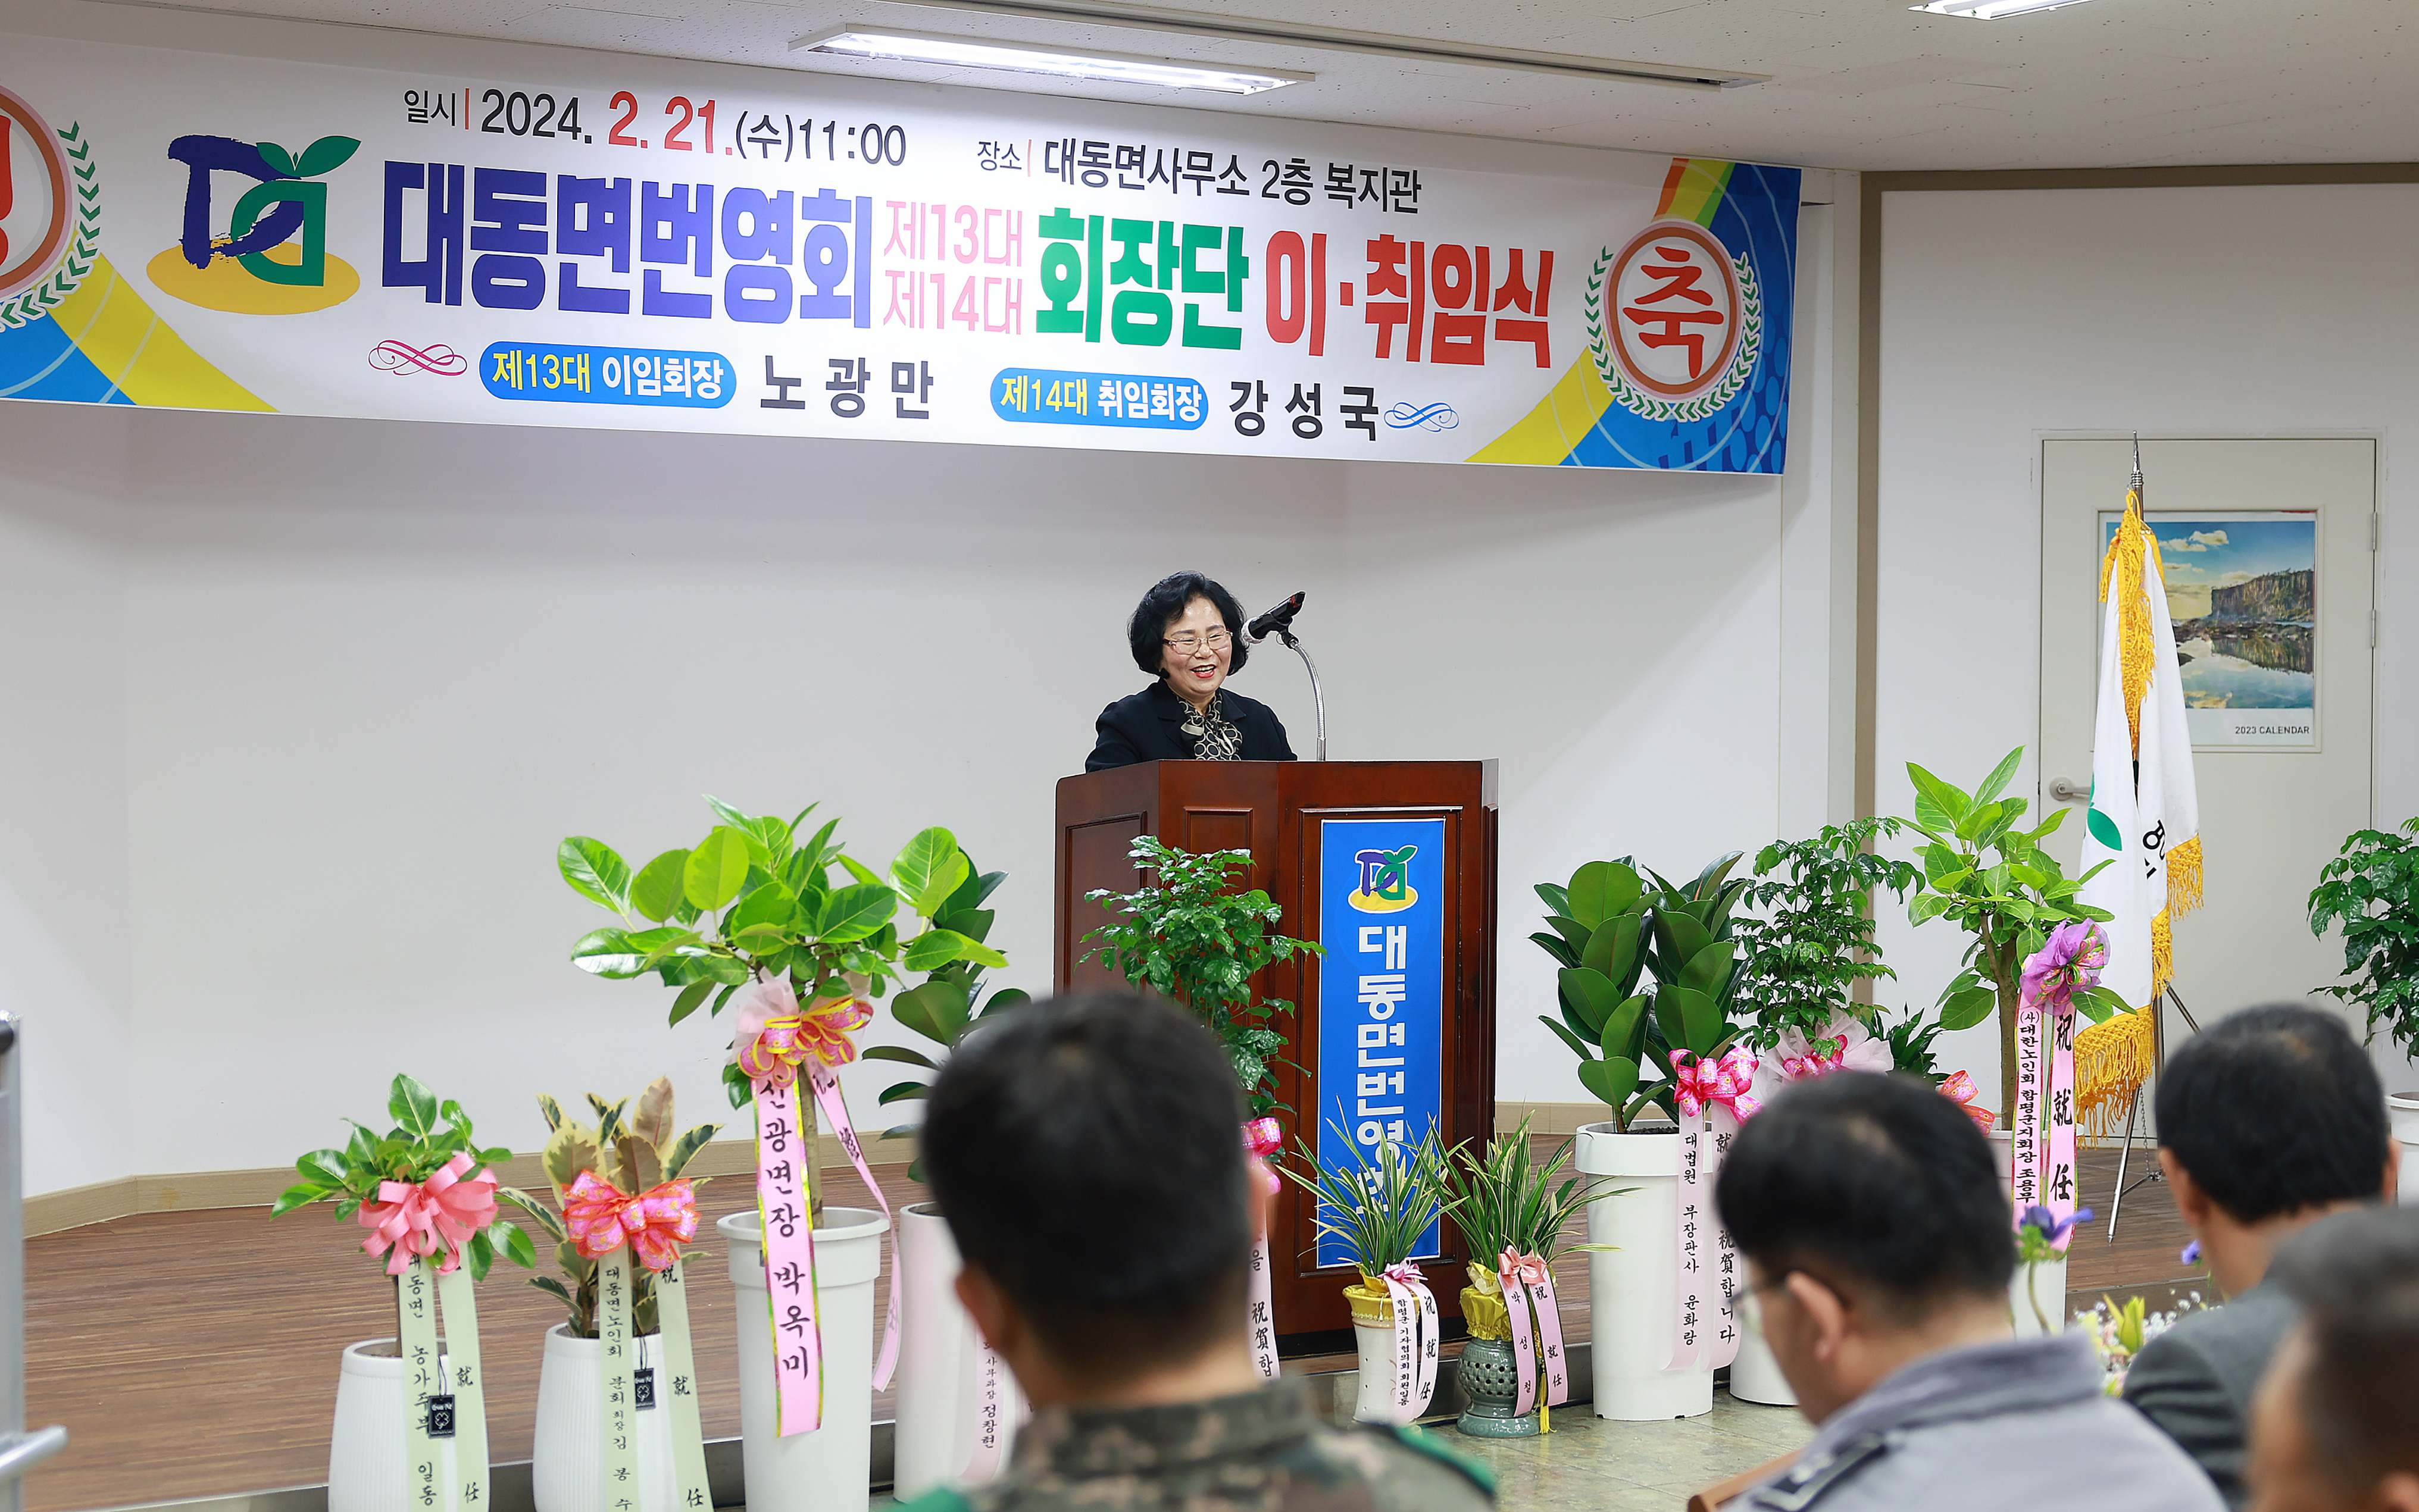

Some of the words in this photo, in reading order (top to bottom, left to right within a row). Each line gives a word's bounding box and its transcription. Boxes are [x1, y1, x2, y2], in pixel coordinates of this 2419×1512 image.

[404, 89, 456, 126] 일시
[481, 89, 592, 144] 2024.
[608, 91, 648, 148] 2.
[977, 140, 1022, 171] 장소
[1044, 138, 1250, 196] 대동면사무소
[1261, 158, 1313, 206] 2층
[1324, 162, 1421, 214] 복지관
[382, 160, 873, 328] 대동면번영회
[884, 200, 1023, 267] 제13대
[883, 270, 1022, 335] 제14대
[1036, 207, 1249, 350] 회장단
[1623, 246, 1724, 379] 축
[492, 350, 591, 394] 제13대
[602, 355, 724, 400] 이임회장
[1000, 375, 1089, 416] 제14대
[1097, 380, 1202, 422] 취임회장
[2235, 726, 2257, 734] 2023
[2259, 726, 2309, 734] CALENDAR
[2016, 1090, 2038, 1164] 함평군지회장
[1684, 1132, 1698, 1185] 대법원
[2015, 1169, 2036, 1203] 조용무
[1683, 1205, 1699, 1274] 부장판사
[773, 1261, 811, 1380] 박옥미
[1683, 1295, 1699, 1345] 윤화랑
[986, 1356, 998, 1400] 사무과장
[982, 1404, 996, 1448] 정창현
[418, 1462, 437, 1507] 일동
